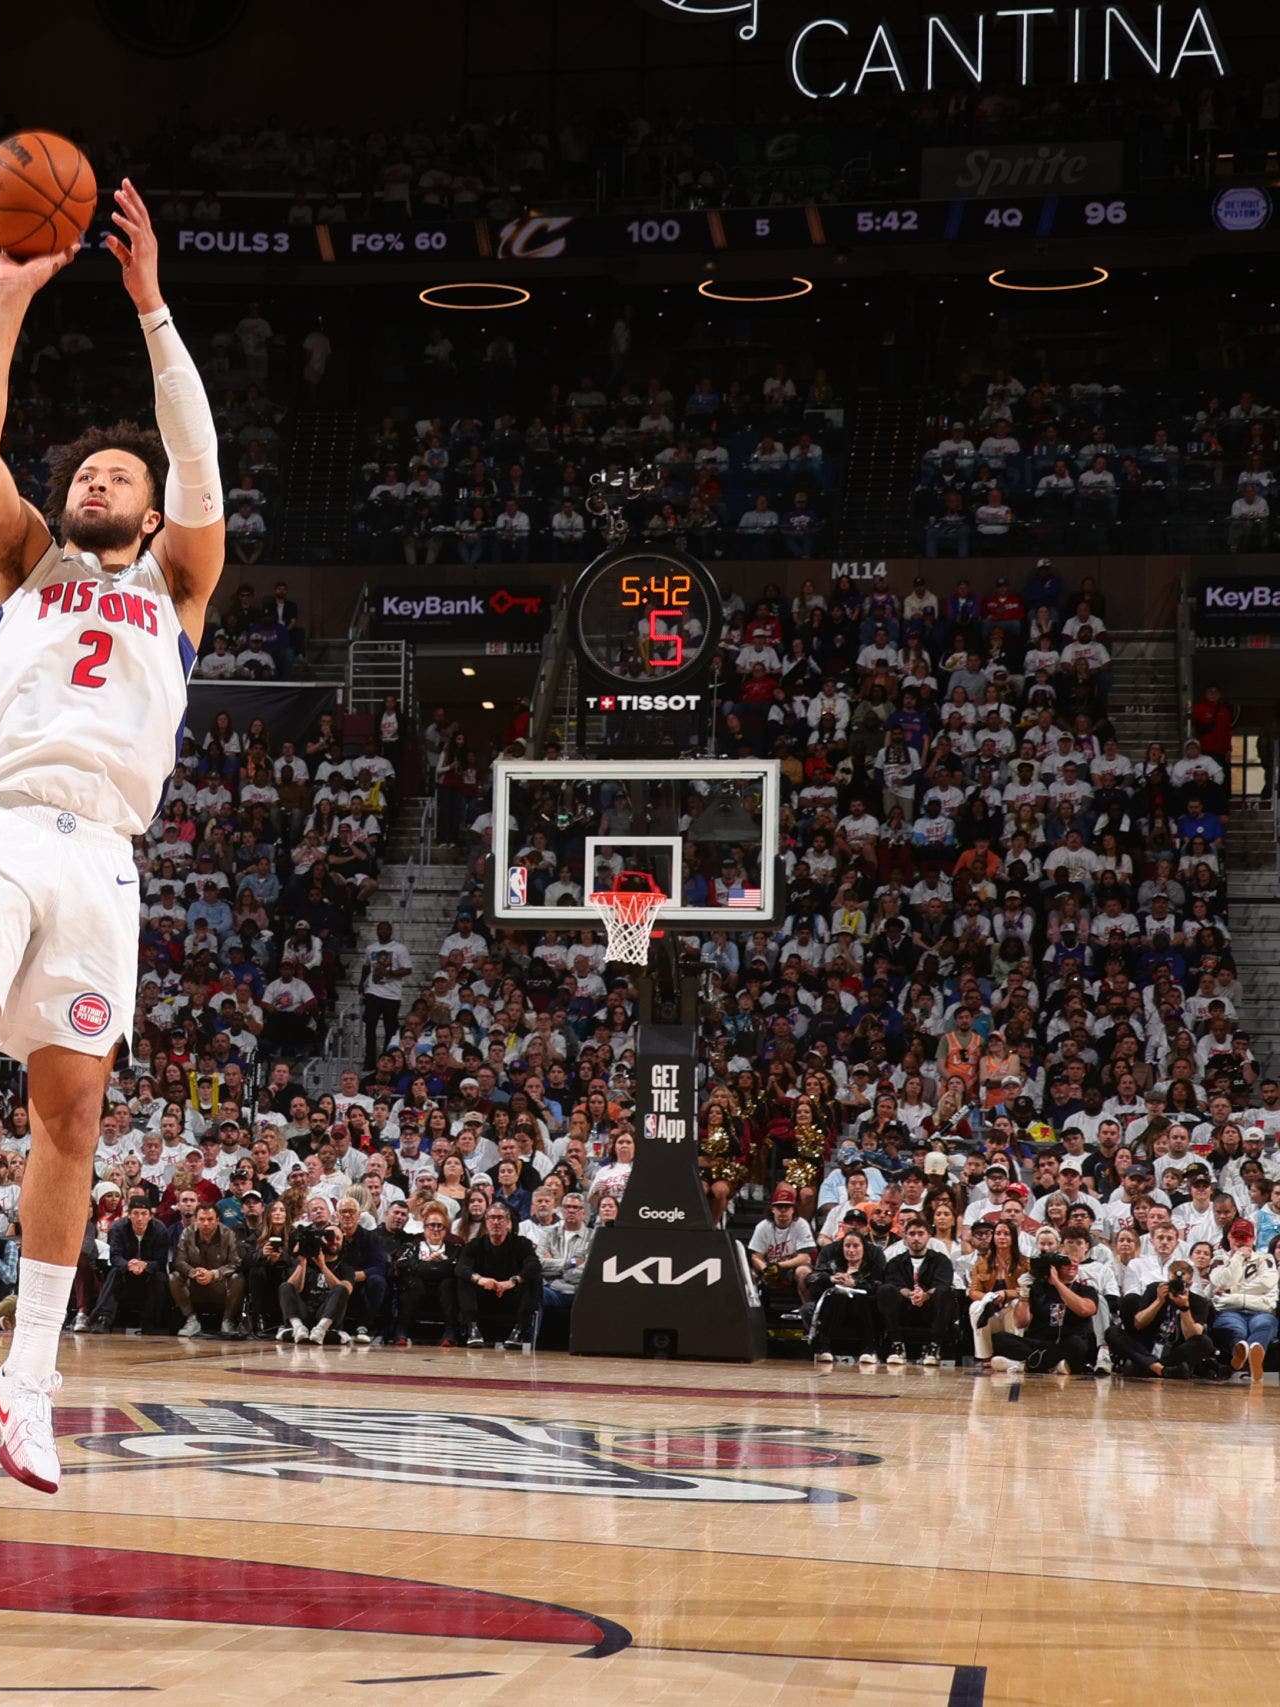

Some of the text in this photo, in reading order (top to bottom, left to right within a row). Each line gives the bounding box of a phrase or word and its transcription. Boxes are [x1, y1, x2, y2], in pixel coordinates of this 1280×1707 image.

[790, 4, 1226, 100] CANTINA
[955, 147, 1090, 198] Sprite
[856, 209, 919, 233] 5:42
[984, 207, 1023, 229] 4Q
[1085, 200, 1127, 226] 96
[626, 219, 680, 244] 100
[755, 218, 770, 237] 5
[178, 230, 291, 253] FOULS 3
[351, 231, 448, 252] FG% 60
[832, 562, 888, 580] M114
[622, 576, 691, 606] 5:42
[382, 596, 485, 619] KeyBank
[650, 610, 684, 667] 5
[71, 630, 113, 688] 2
[617, 695, 701, 711] TISSOT
[651, 1064, 680, 1089] GET
[651, 1089, 680, 1113] THE
[657, 1114, 686, 1144] App
[638, 1206, 686, 1223] Google
[602, 1255, 722, 1287] KIA
